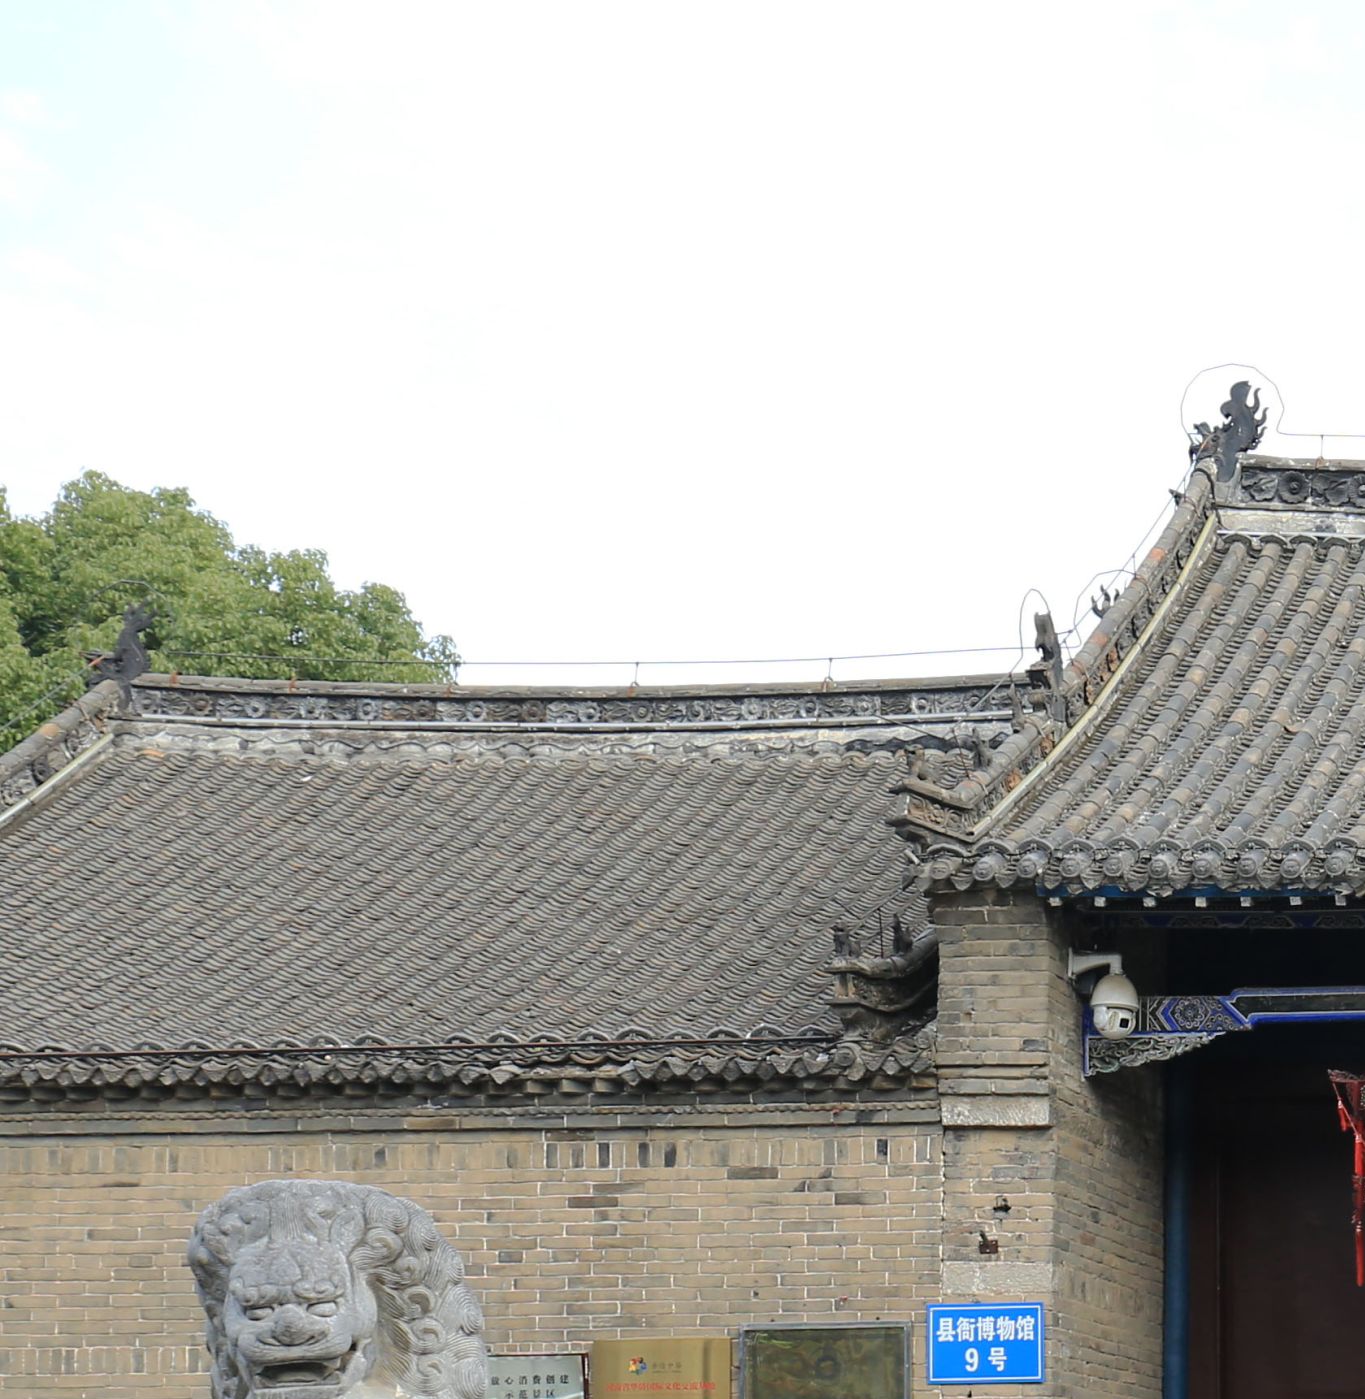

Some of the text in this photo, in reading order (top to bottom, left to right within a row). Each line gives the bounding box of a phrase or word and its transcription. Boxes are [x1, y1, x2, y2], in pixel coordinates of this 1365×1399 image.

[936, 1315, 1036, 1343] 县衙博物馆
[965, 1346, 1008, 1372] 9 号
